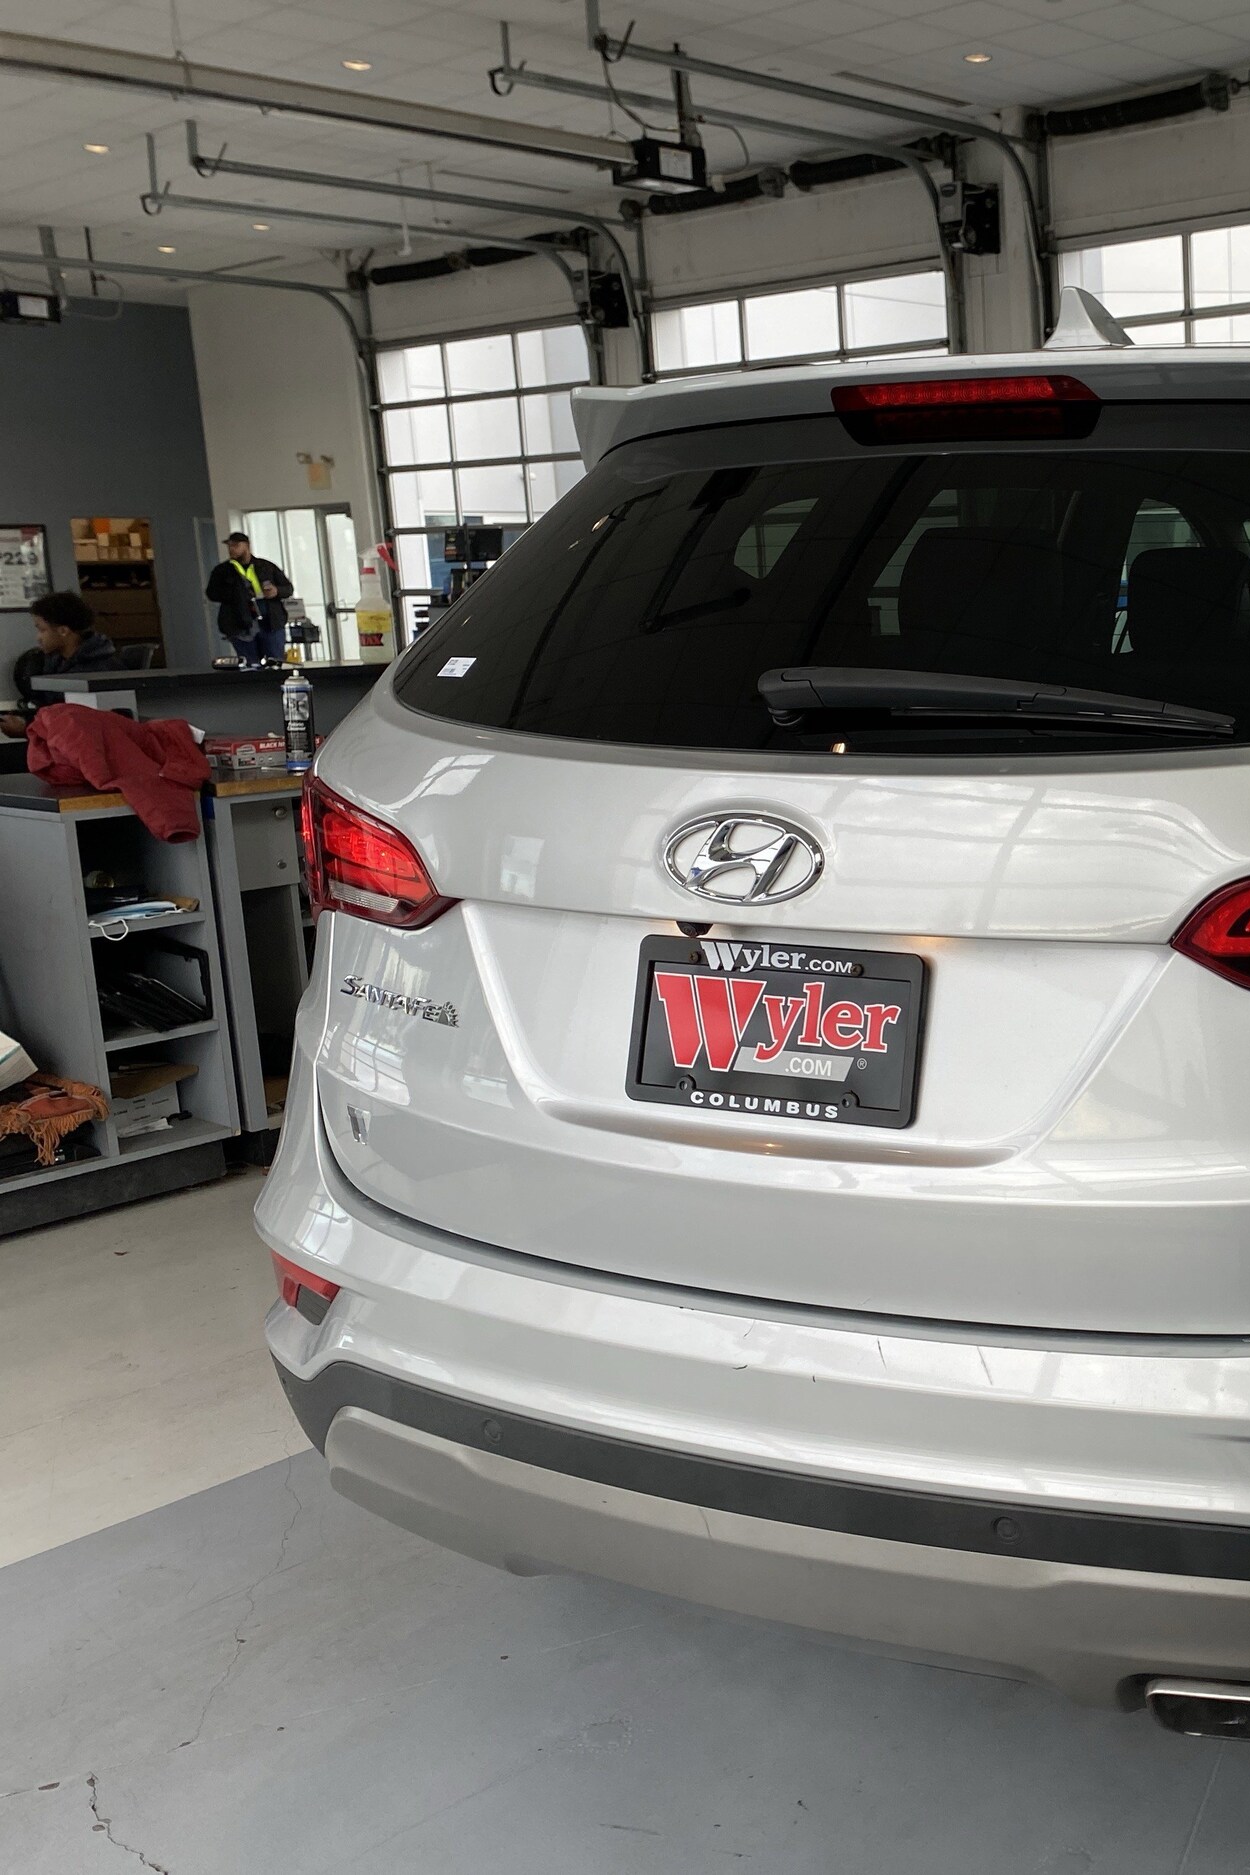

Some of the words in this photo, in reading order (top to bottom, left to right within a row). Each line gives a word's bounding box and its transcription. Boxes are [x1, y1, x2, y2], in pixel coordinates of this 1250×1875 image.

[654, 971, 902, 1072] Wyler
[784, 1056, 832, 1077] .COM
[690, 1091, 839, 1119] COLUMBUS
